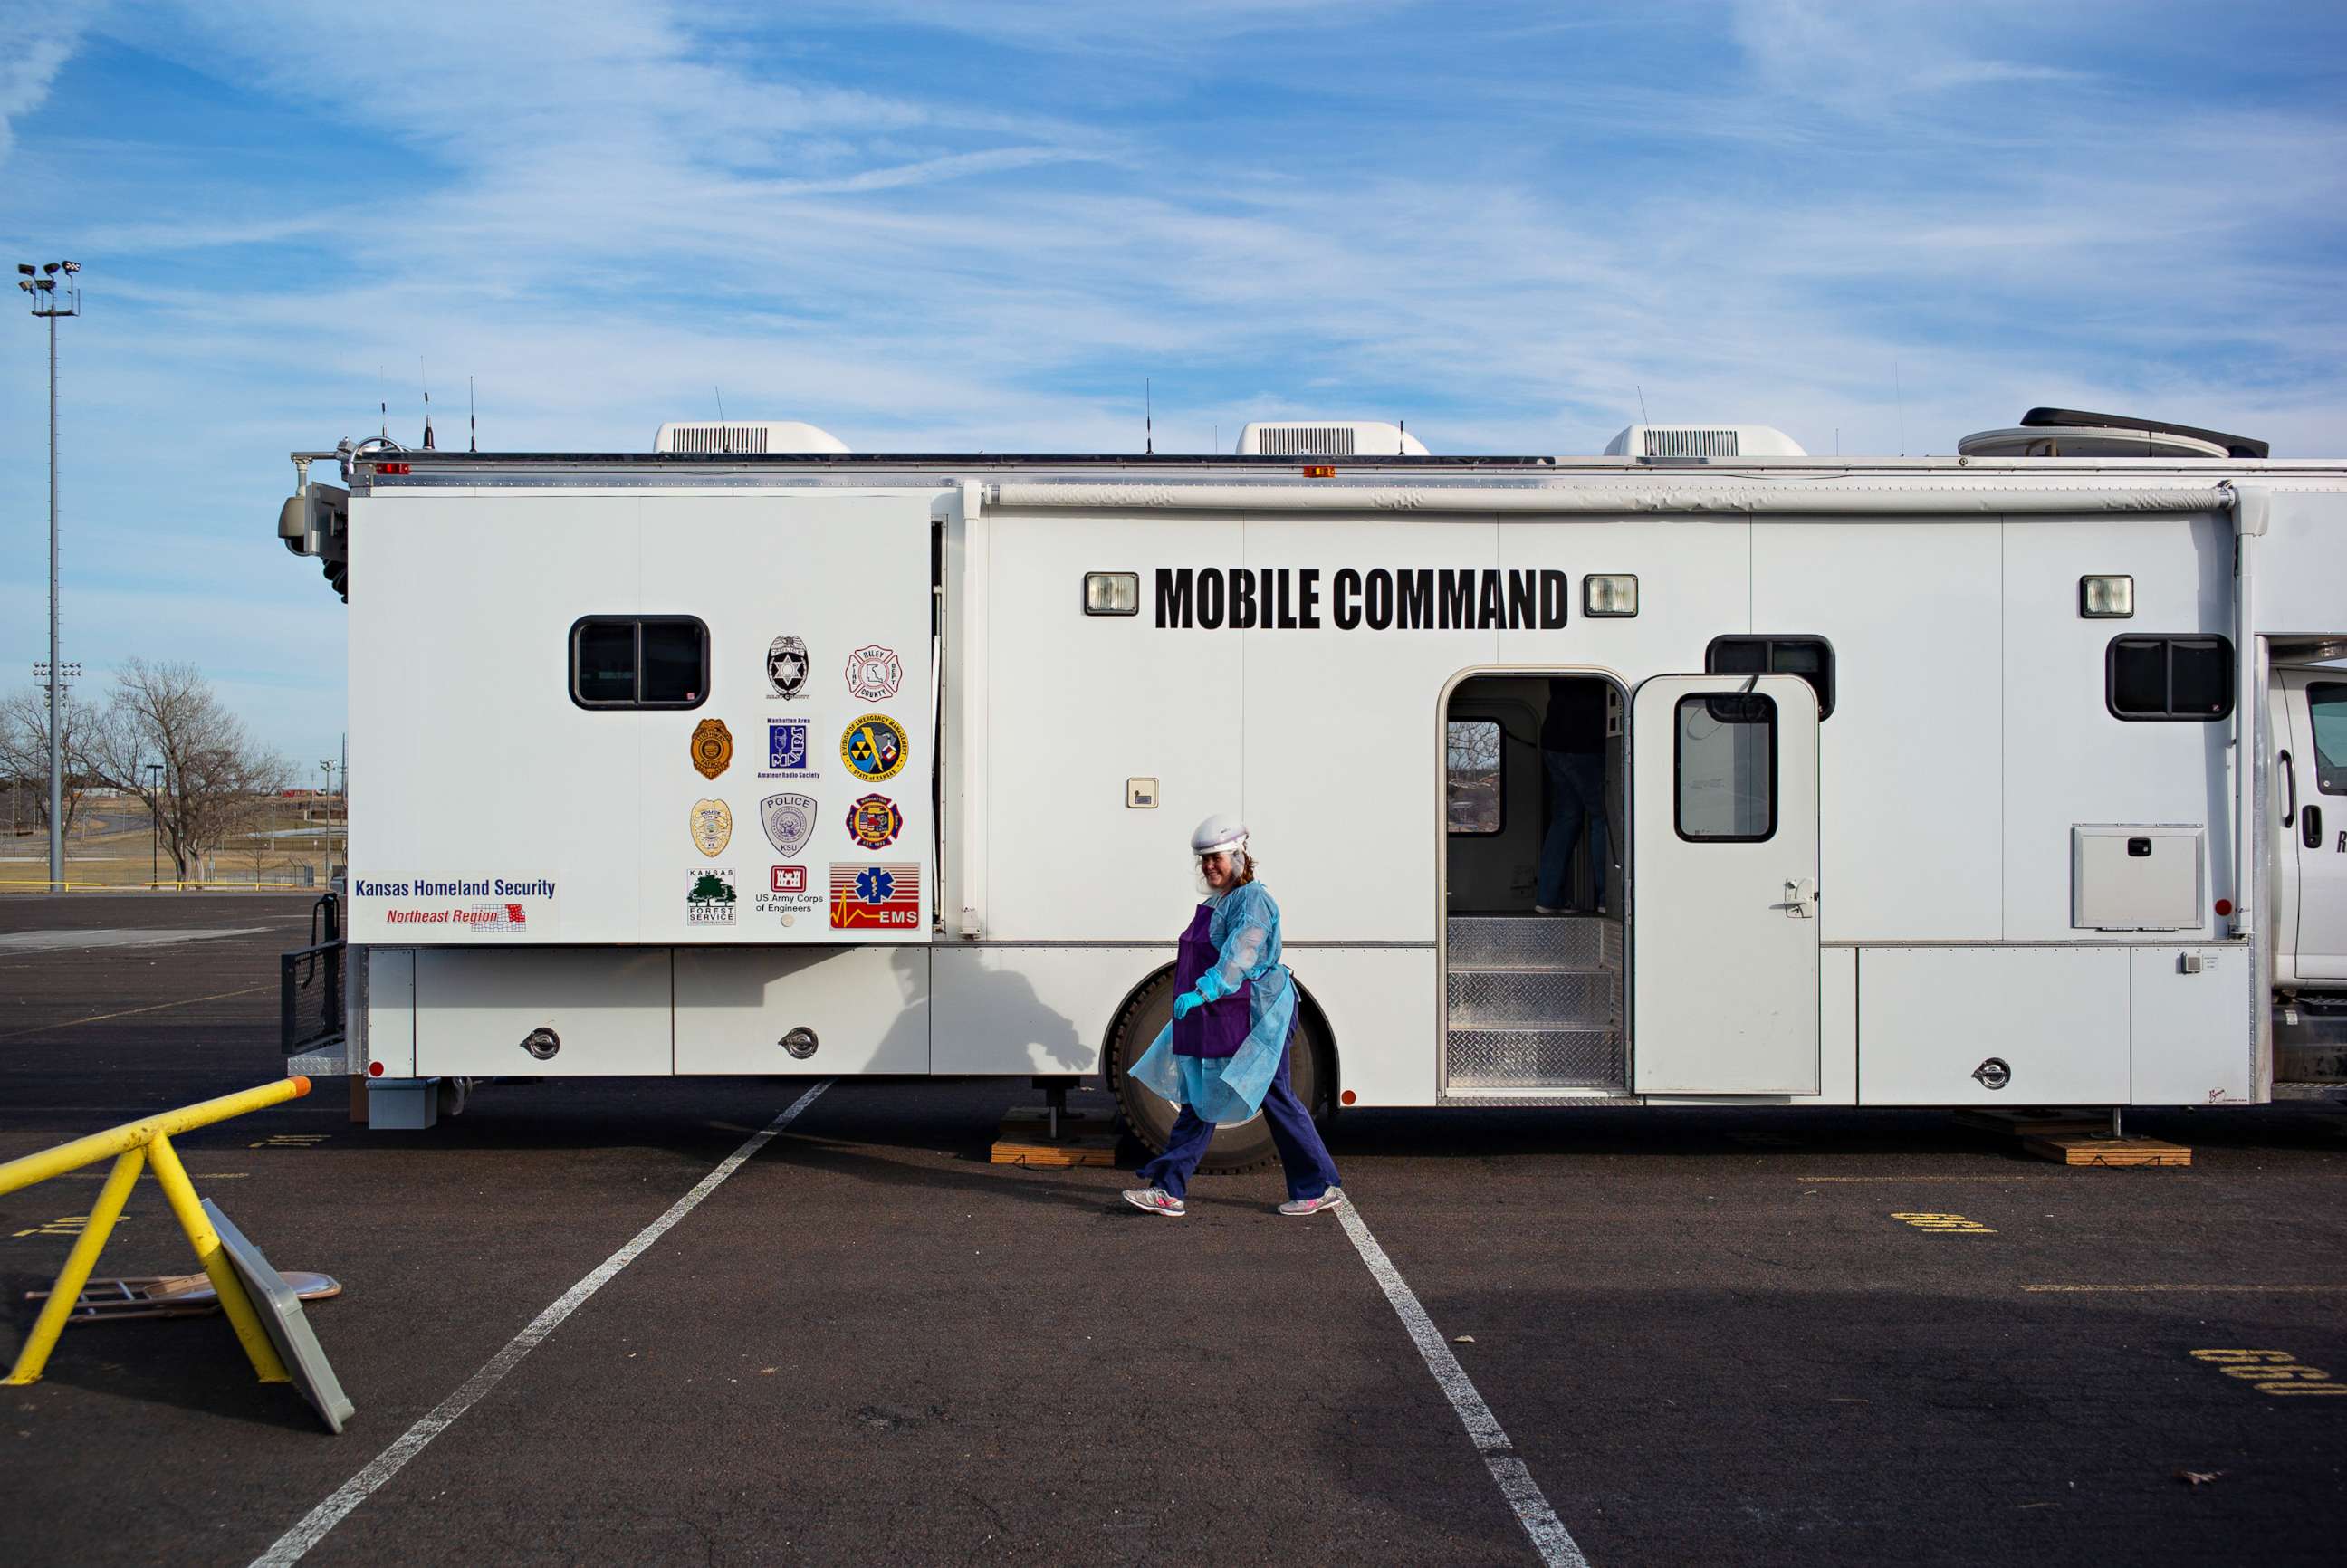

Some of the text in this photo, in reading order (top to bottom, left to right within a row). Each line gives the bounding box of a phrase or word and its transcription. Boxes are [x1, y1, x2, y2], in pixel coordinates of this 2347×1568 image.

[1155, 568, 1568, 630] MOBILE COMMAND
[863, 650, 885, 659] RILEY
[860, 688, 886, 698] COUNTY
[855, 715, 889, 726] EMERGENCY
[696, 730, 726, 741] HIGHWAY
[767, 797, 810, 808] POLICE
[355, 879, 556, 899] Kansas Homeland Security
[755, 894, 824, 904] US Army Corps
[768, 904, 811, 913] Engineers
[387, 910, 498, 927] Northeast Region
[879, 911, 918, 923] EMS
